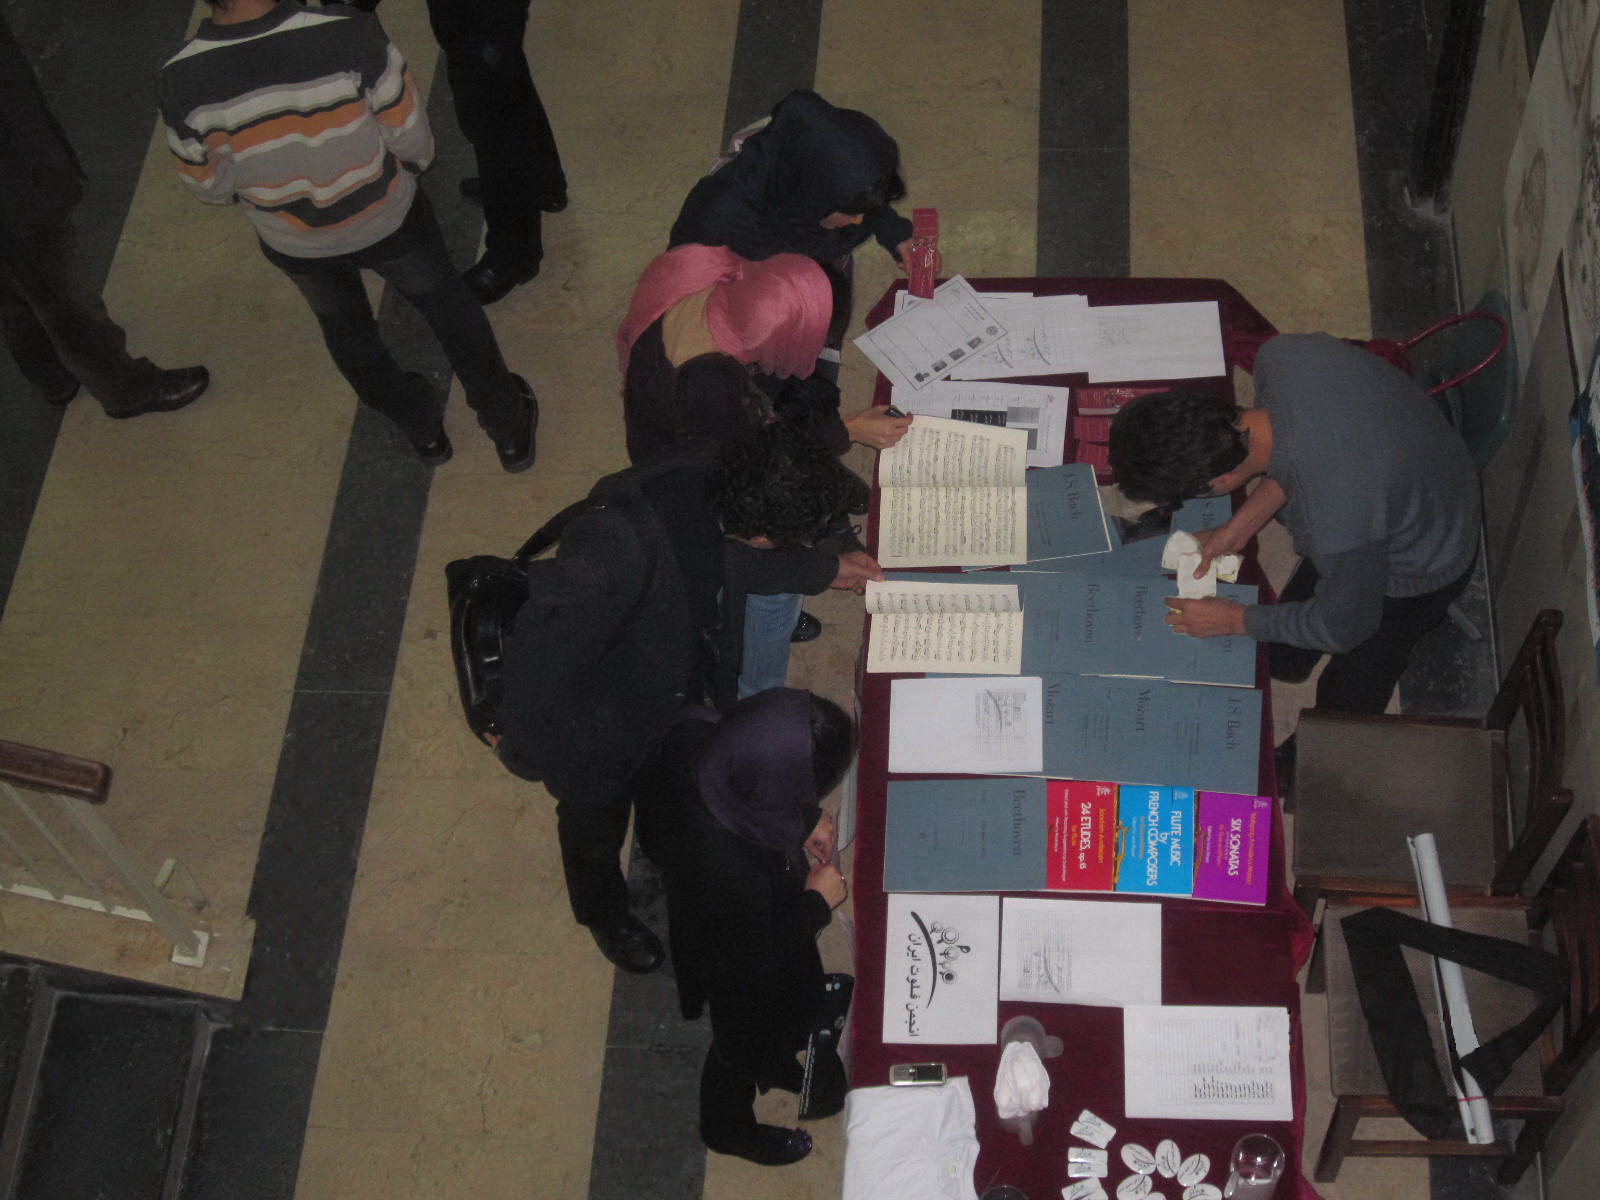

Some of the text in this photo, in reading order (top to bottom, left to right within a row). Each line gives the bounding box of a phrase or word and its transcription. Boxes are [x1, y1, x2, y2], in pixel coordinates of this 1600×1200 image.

[1067, 492, 1083, 520] Bach
[1084, 584, 1101, 643] Beethoven
[1134, 585, 1149, 640] Beethove
[1045, 683, 1062, 726] Mozart
[1136, 689, 1152, 732] Mozart
[1225, 720, 1241, 750] Bach
[1012, 789, 1026, 857] Beethoven
[1081, 802, 1092, 815] 24
[1098, 808, 1106, 833] Joachim
[1170, 810, 1182, 836] FLUTE
[1079, 816, 1092, 851] ETUDES,
[1146, 791, 1160, 887] FRENCH COMPOSERS
[1159, 832, 1170, 844] by
[1170, 838, 1181, 866] MUSIC
[1228, 818, 1242, 877] SIX SONATAS
[906, 933, 922, 1037] انجمن فلوت ایران
